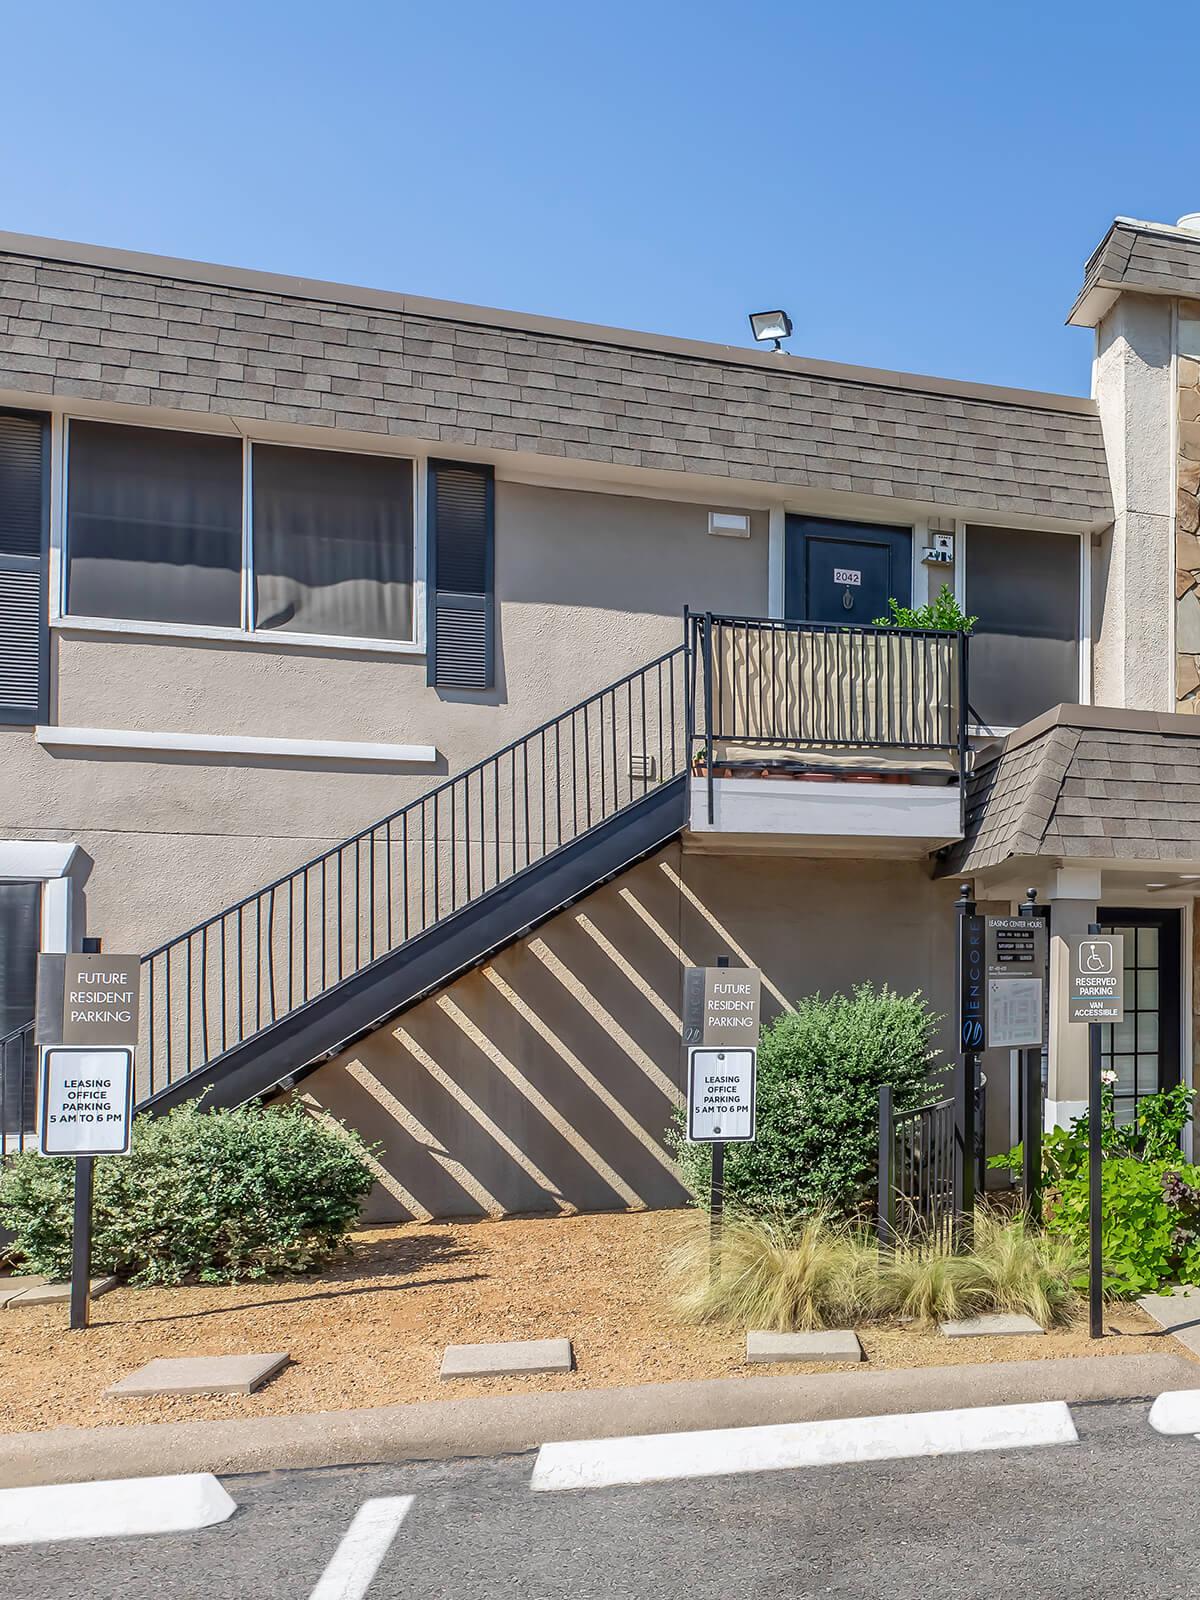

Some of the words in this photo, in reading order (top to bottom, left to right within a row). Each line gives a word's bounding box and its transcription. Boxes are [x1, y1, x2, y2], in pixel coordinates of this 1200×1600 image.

[836, 571, 859, 583] 2042
[988, 919, 1009, 927] LEASING
[1009, 920, 1026, 928] CENTER
[969, 923, 980, 1009] ENCORE
[77, 972, 128, 985] FUTURE
[1075, 977, 1117, 986] RESERVED
[713, 983, 751, 995] FUTURE
[1079, 987, 1113, 995] PARKING
[69, 991, 134, 1003] RESIDENT
[707, 1000, 755, 1011] RESIDENT
[1089, 1001, 1104, 1009] VAN
[71, 1010, 132, 1023] PARKING
[1074, 1008, 1118, 1017] ACCESSIBLE
[708, 1016, 753, 1028] PARKING
[64, 1079, 111, 1088] LEASING
[67, 1091, 107, 1100] OFFICE
[62, 1102, 111, 1111] PARKING
[50, 1115, 57, 1123] 5
[59, 1115, 76, 1123] AM
[80, 1114, 94, 1122] TO
[97, 1114, 103, 1122] 6
[106, 1114, 122, 1122] PM
